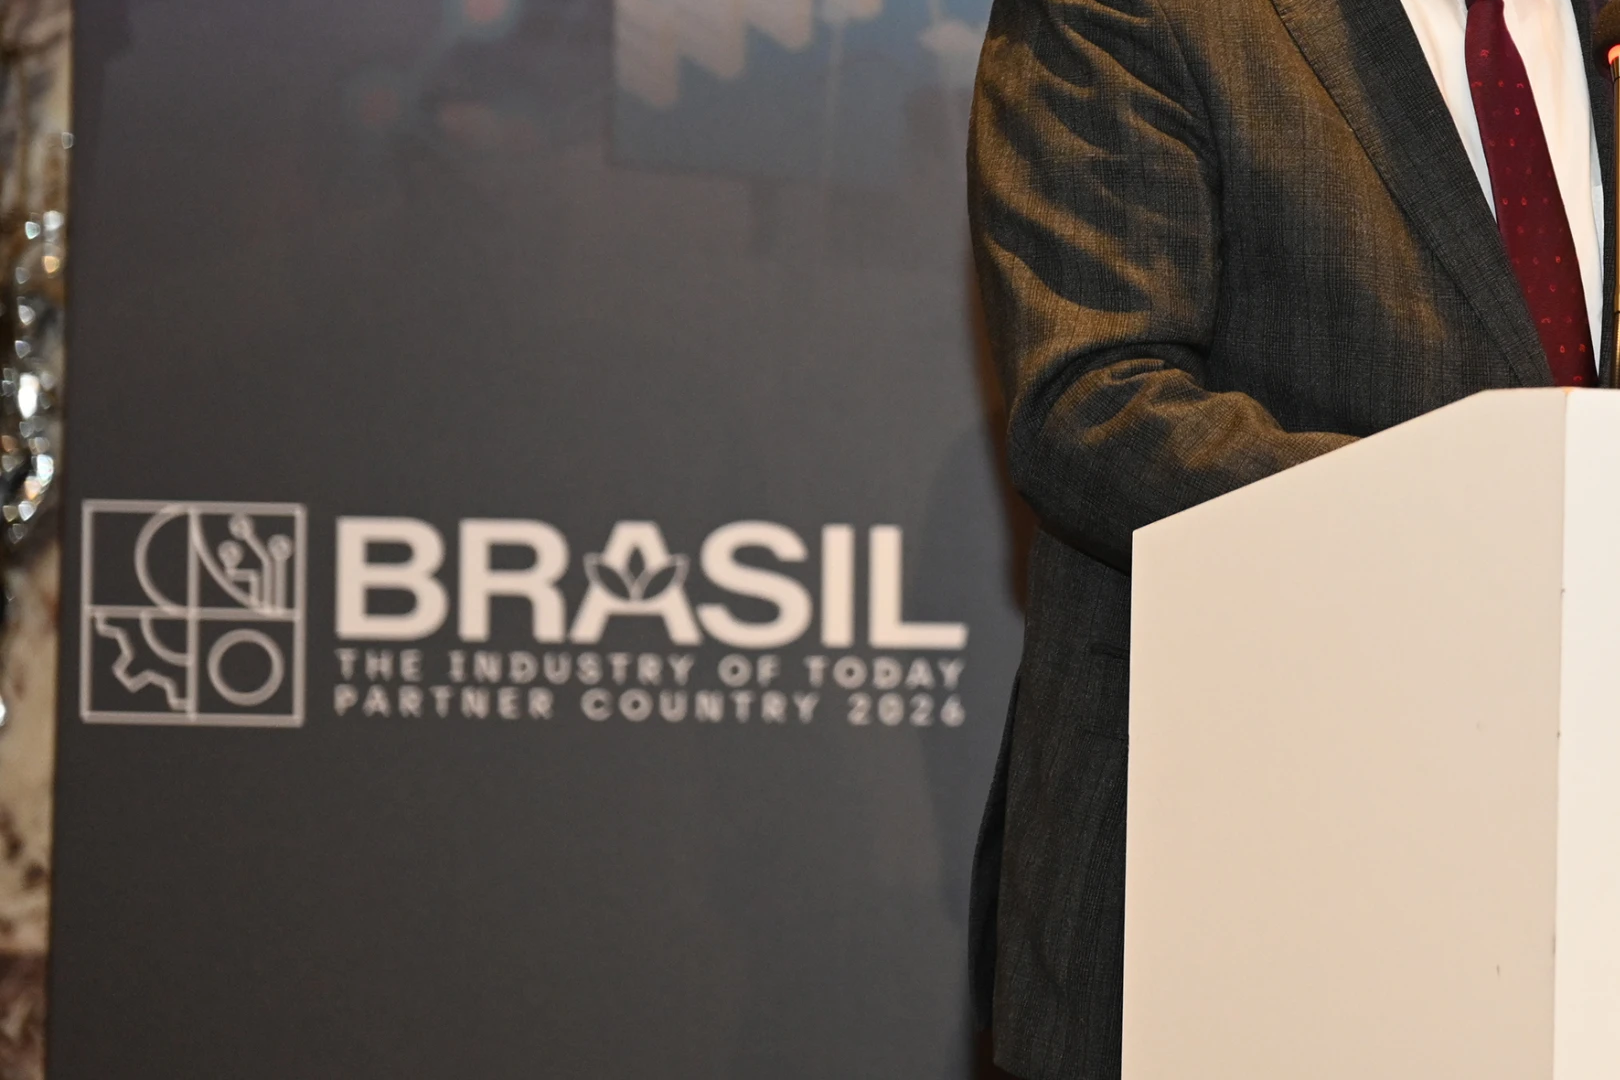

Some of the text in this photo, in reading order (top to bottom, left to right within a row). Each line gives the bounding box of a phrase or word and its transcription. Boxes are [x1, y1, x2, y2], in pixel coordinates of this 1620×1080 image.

[335, 517, 968, 649] BRASIL
[335, 648, 966, 690] THE INDUSTRY OF TODAY
[334, 683, 966, 727] PARTNER COUNTRY 2026
